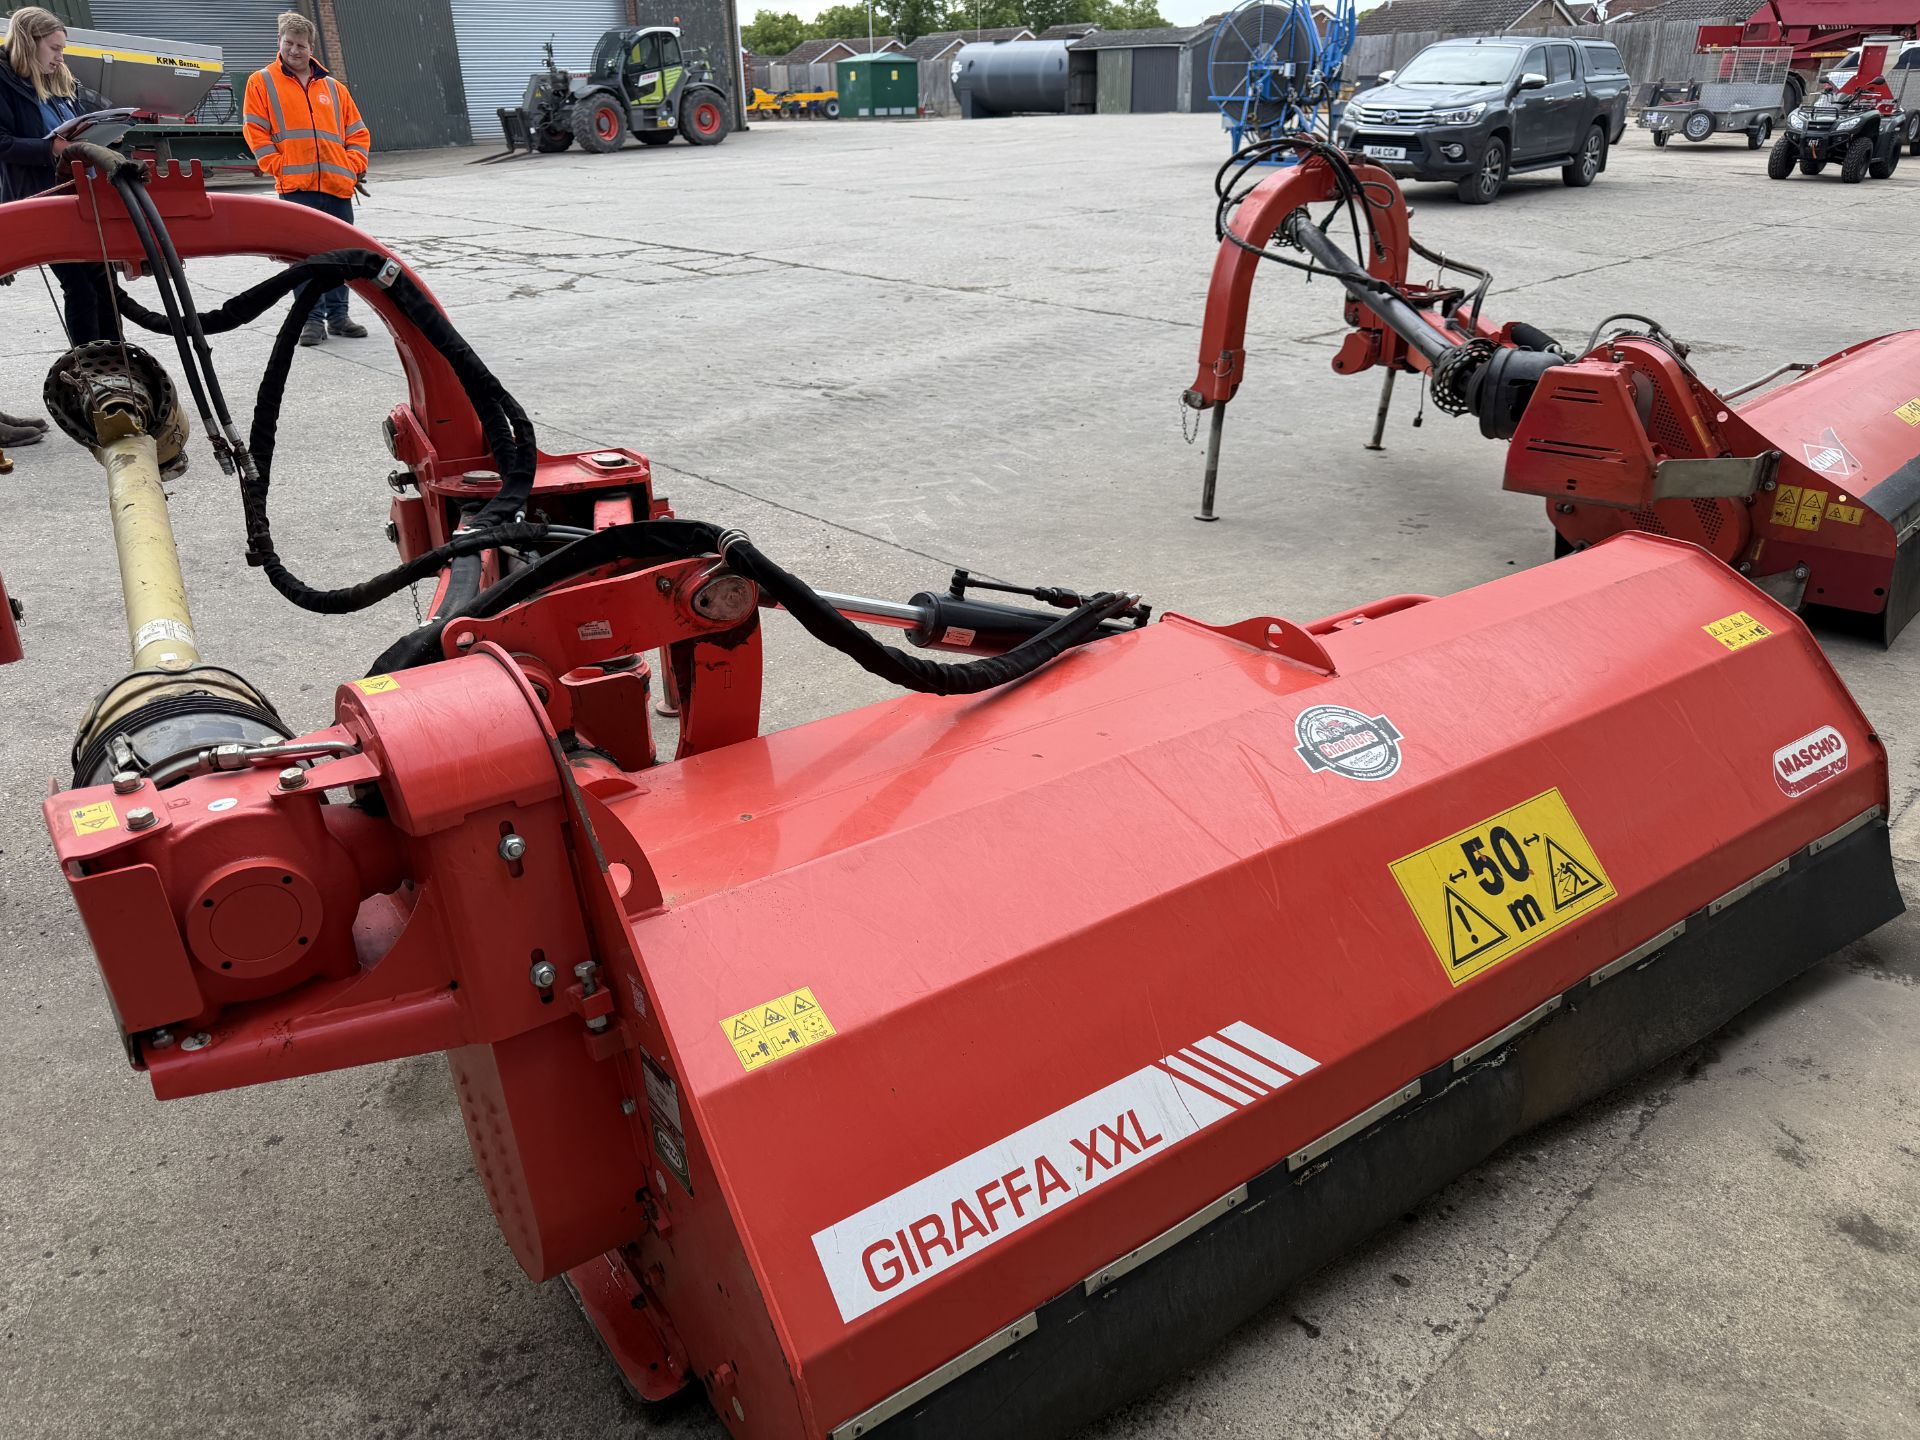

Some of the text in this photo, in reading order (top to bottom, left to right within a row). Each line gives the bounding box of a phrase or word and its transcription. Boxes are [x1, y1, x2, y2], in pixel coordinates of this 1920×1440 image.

[156, 56, 178, 66] KRM
[1809, 448, 1844, 472] KUHN
[1320, 730, 1377, 757] Chandlers
[1778, 734, 1841, 777] MASCHIO
[1460, 826, 1530, 896] 50
[1507, 893, 1546, 933] m
[810, 1029, 828, 1041] STOP
[861, 1108, 1163, 1293] GIRAFFA XXL
